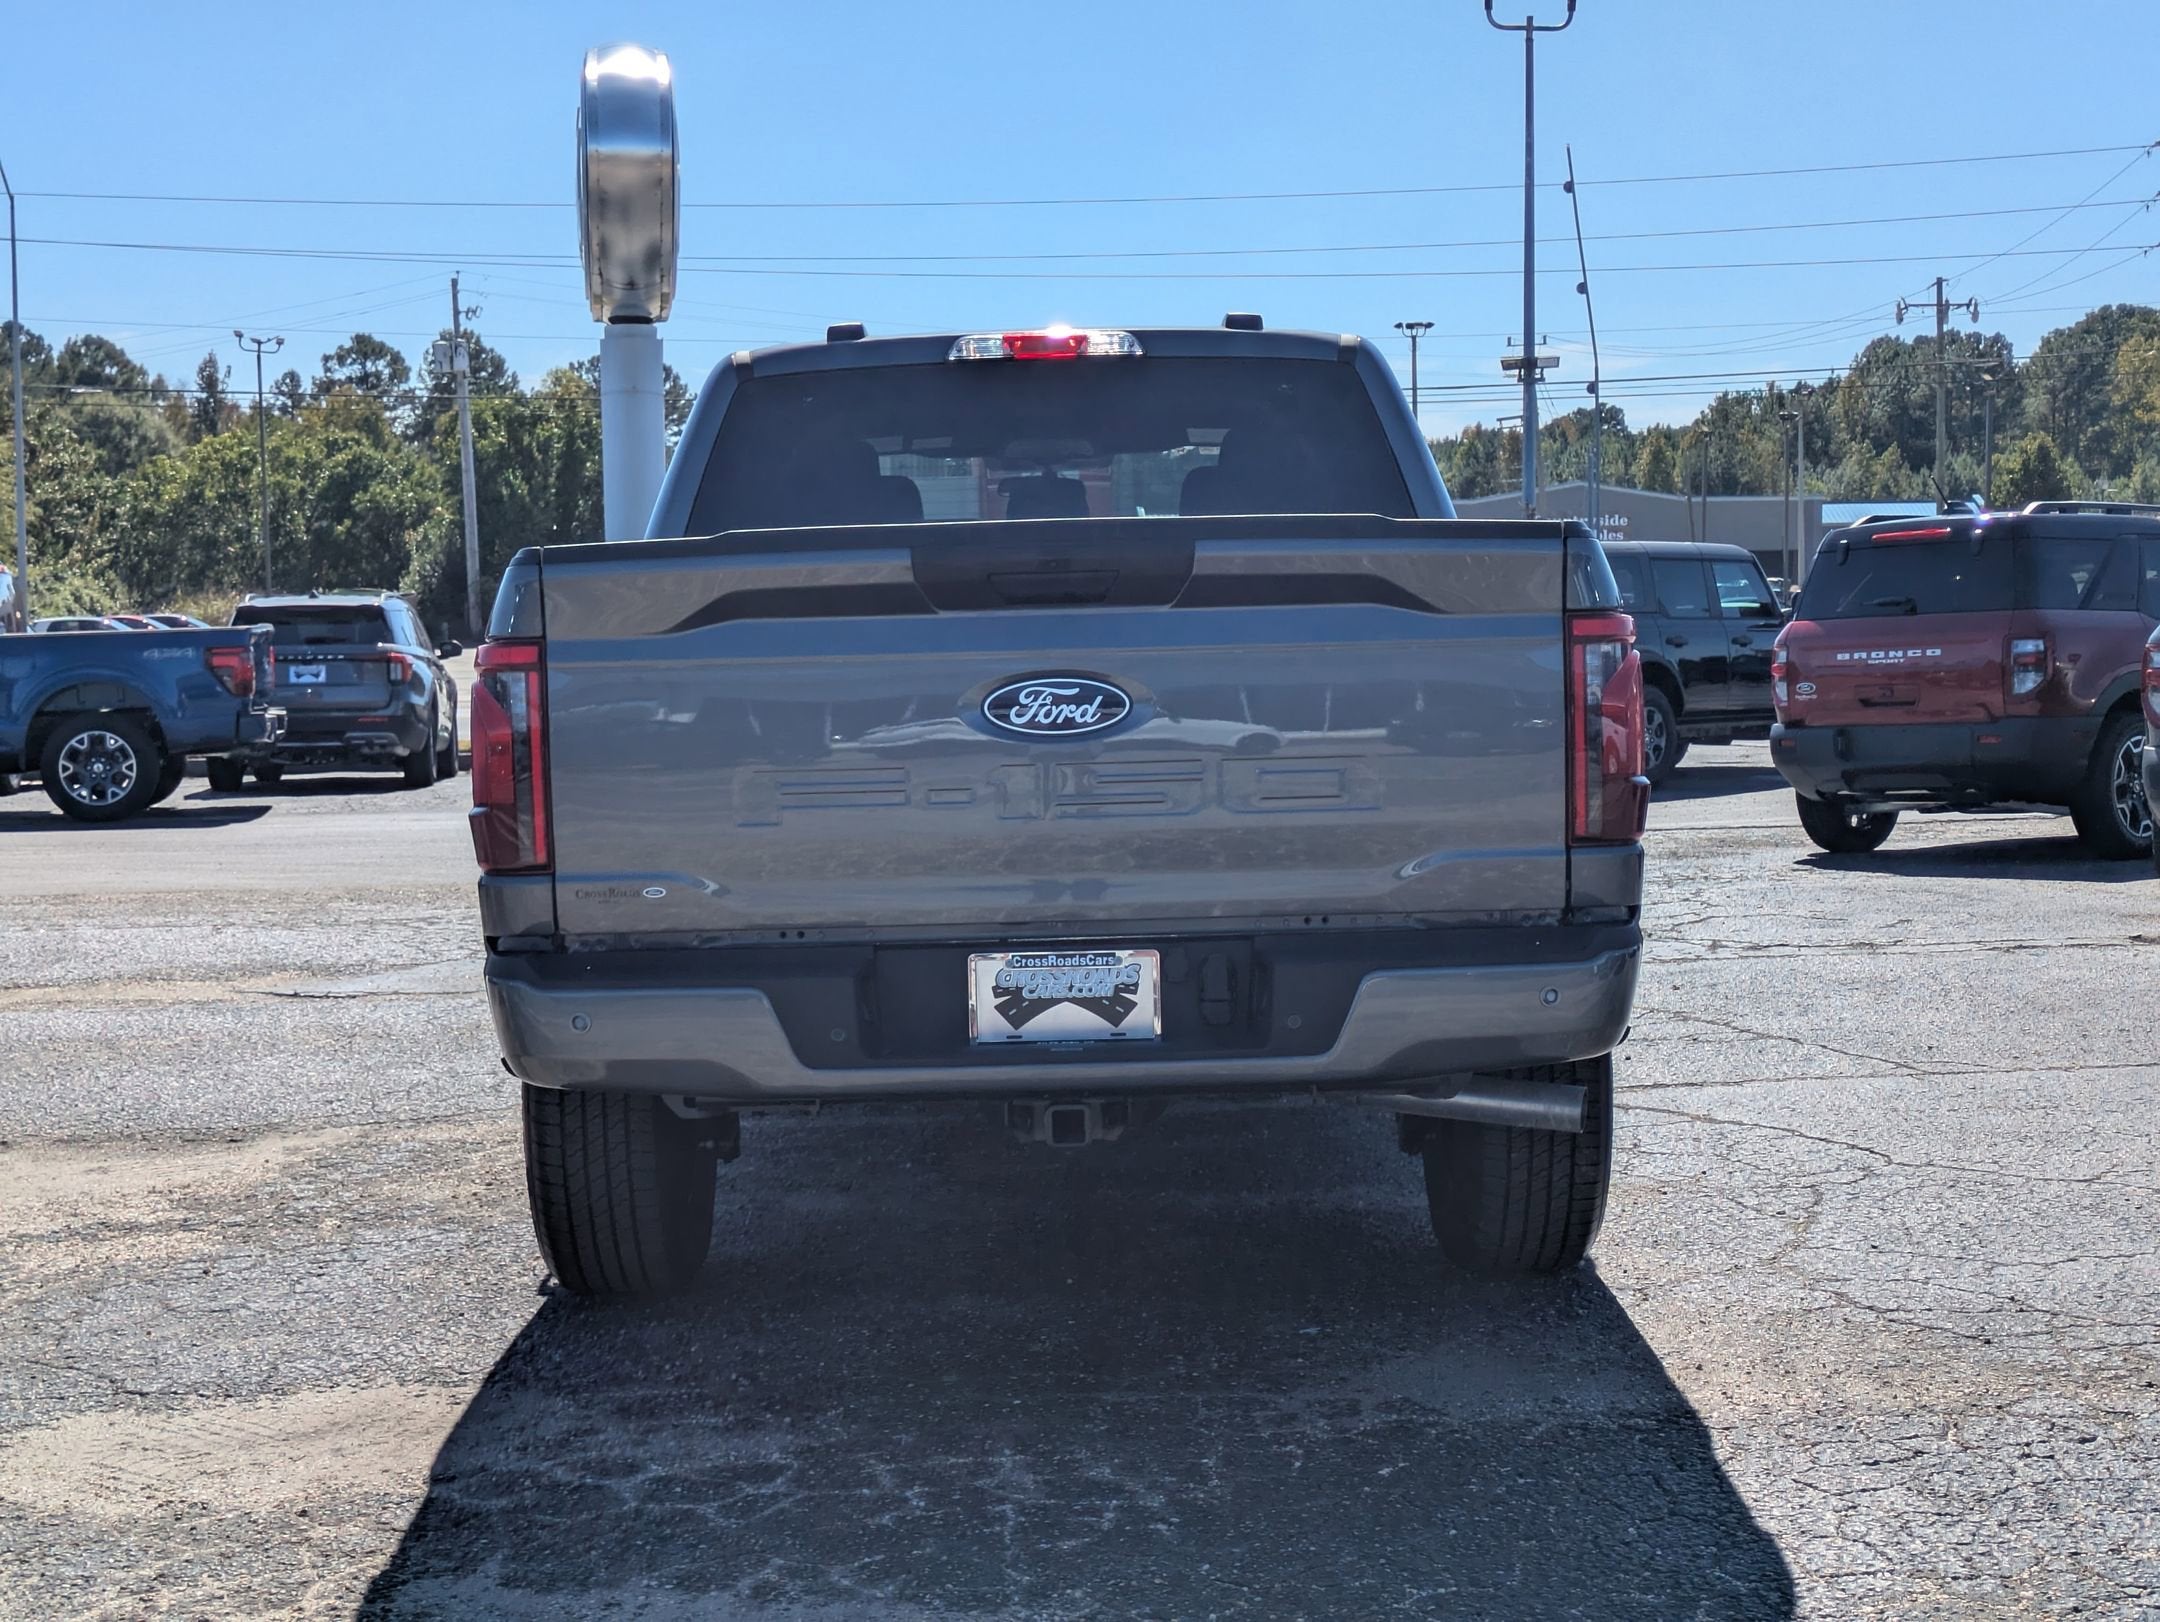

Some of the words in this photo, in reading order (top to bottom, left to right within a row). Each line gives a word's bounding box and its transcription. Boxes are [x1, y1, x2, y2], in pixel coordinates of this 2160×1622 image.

[1836, 648, 1942, 661] BRONCO
[1009, 686, 1104, 725] Ford
[732, 753, 1382, 828] F-150
[1012, 954, 1115, 968] CrossRoadsCars
[995, 963, 1142, 988] CROSSROADS
[1022, 982, 1115, 999] CARS.COM
